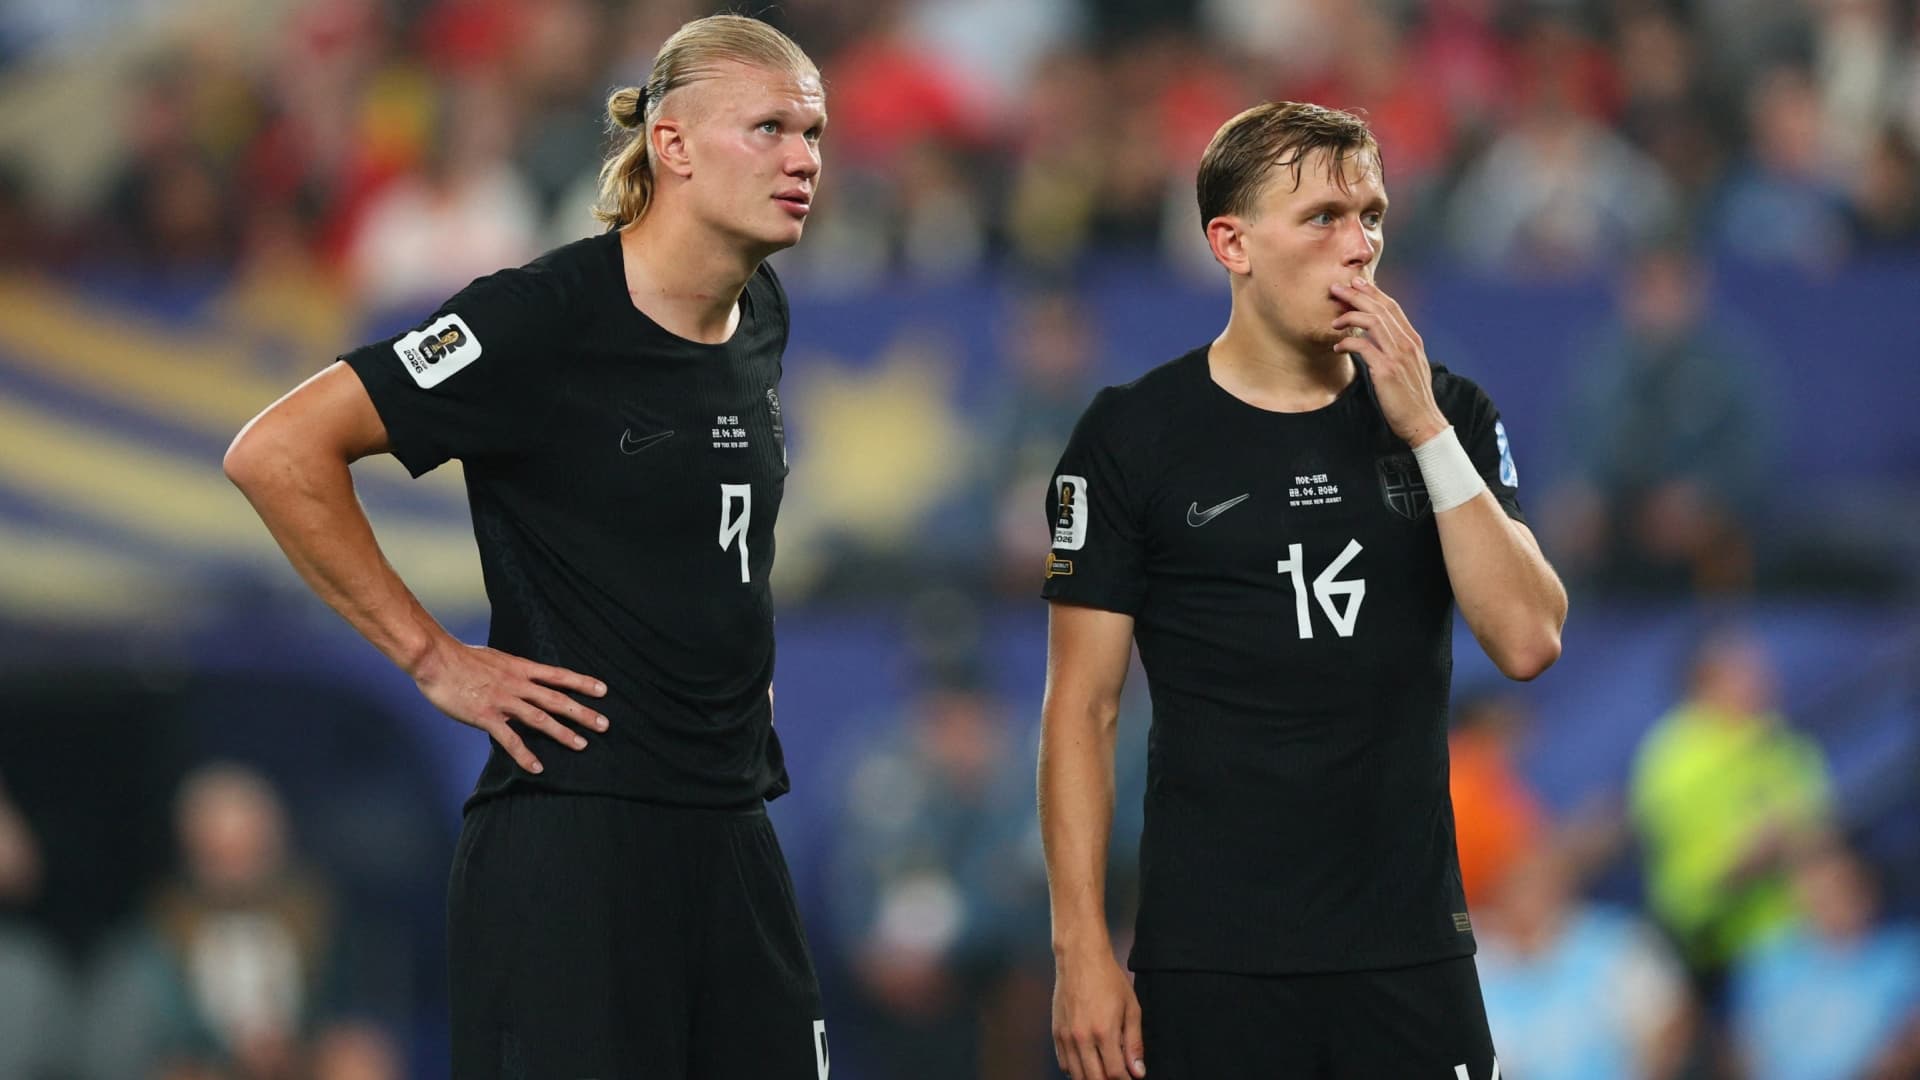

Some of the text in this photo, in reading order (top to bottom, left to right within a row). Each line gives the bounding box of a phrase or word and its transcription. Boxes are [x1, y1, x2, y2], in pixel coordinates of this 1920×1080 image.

[403, 350, 424, 374] 2026
[1289, 485, 1338, 497] 22.06.2026
[719, 483, 751, 583] 9
[1277, 538, 1366, 639] 16
